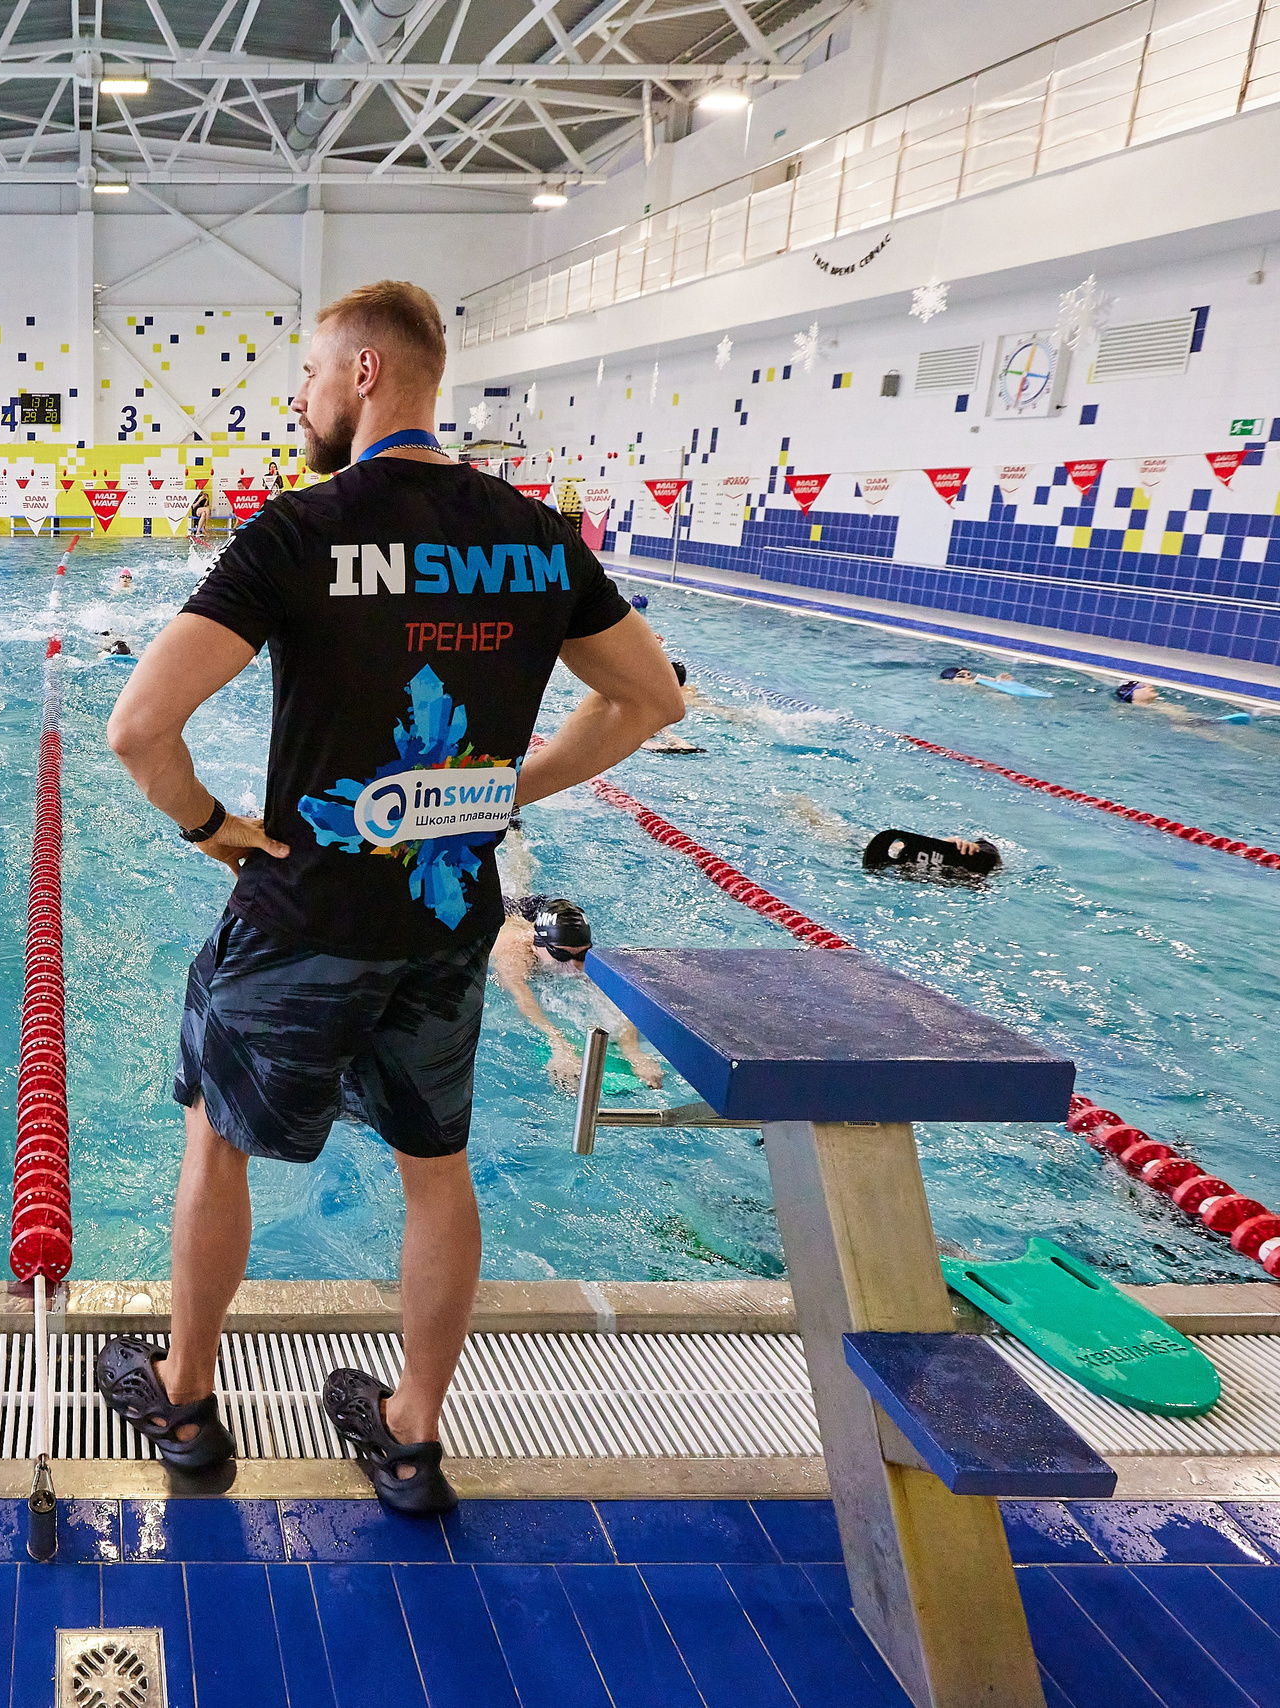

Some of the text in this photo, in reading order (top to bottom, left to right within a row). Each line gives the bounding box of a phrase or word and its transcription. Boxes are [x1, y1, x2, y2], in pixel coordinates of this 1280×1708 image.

[1, 405, 19, 432] 4
[120, 405, 137, 432] 3
[228, 405, 246, 432] 2
[405, 621, 514, 652] ТРЕНЕР
[416, 815, 456, 826] Школа
